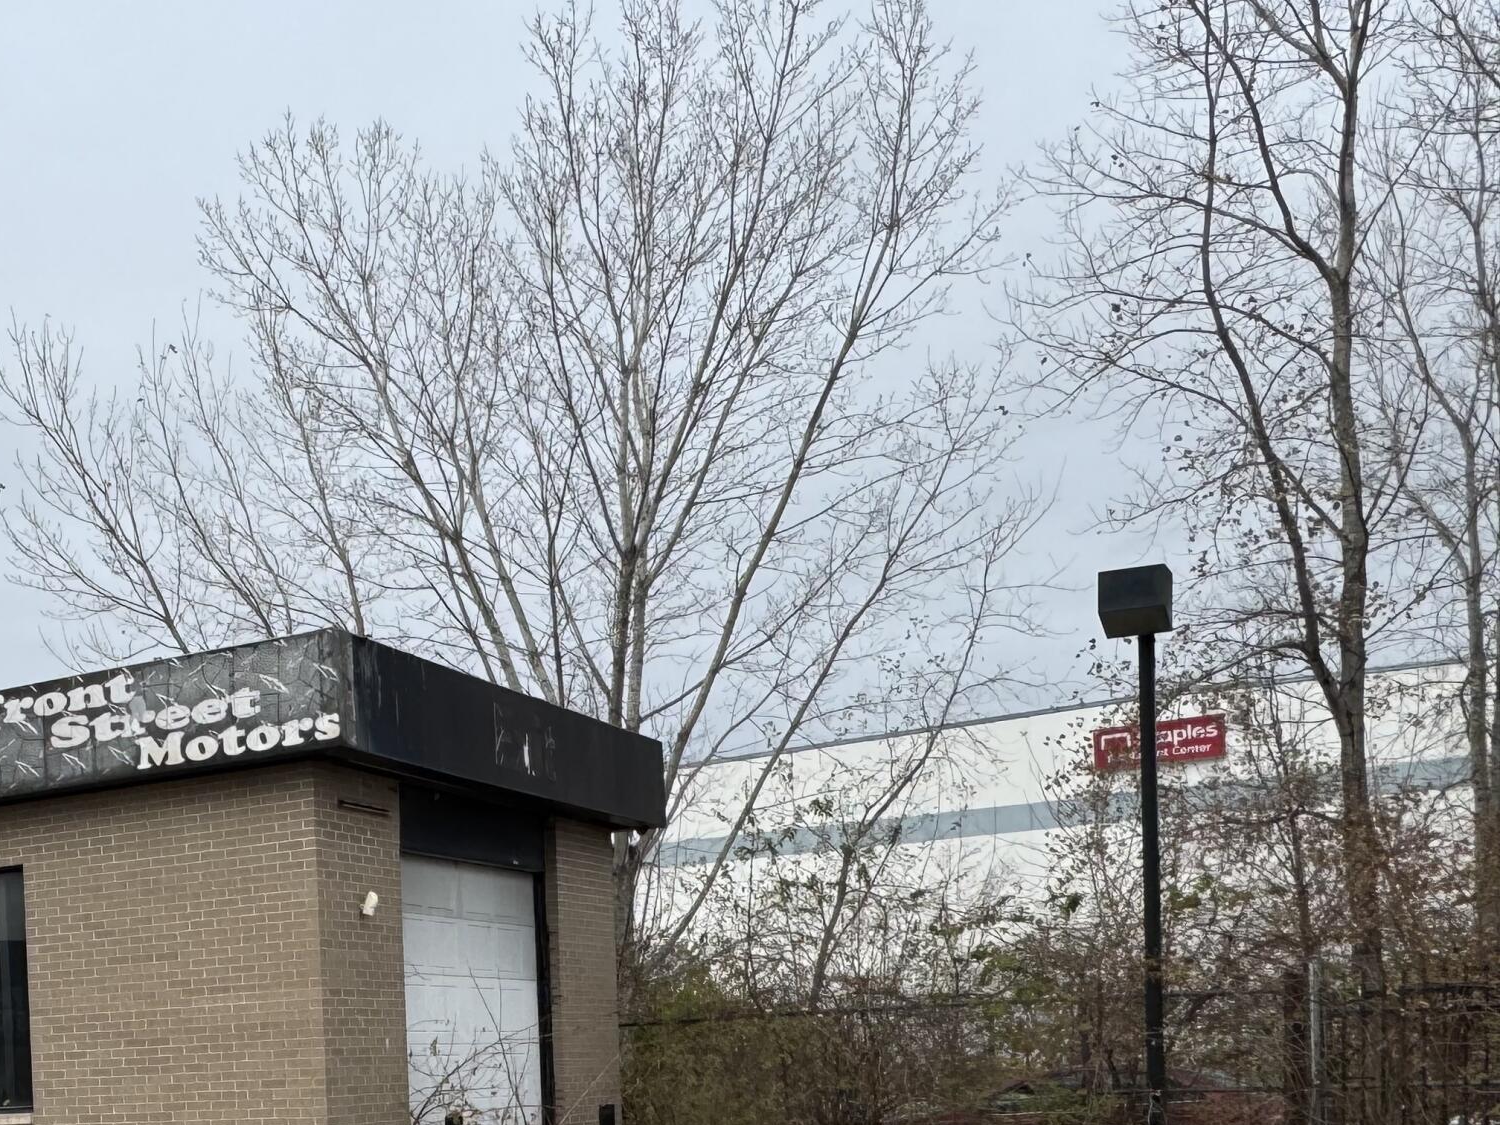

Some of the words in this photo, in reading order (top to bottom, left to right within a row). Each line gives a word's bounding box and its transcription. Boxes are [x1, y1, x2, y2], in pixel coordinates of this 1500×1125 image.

[51, 687, 260, 748] Street
[136, 712, 341, 770] Motors
[1137, 723, 1218, 746] aples
